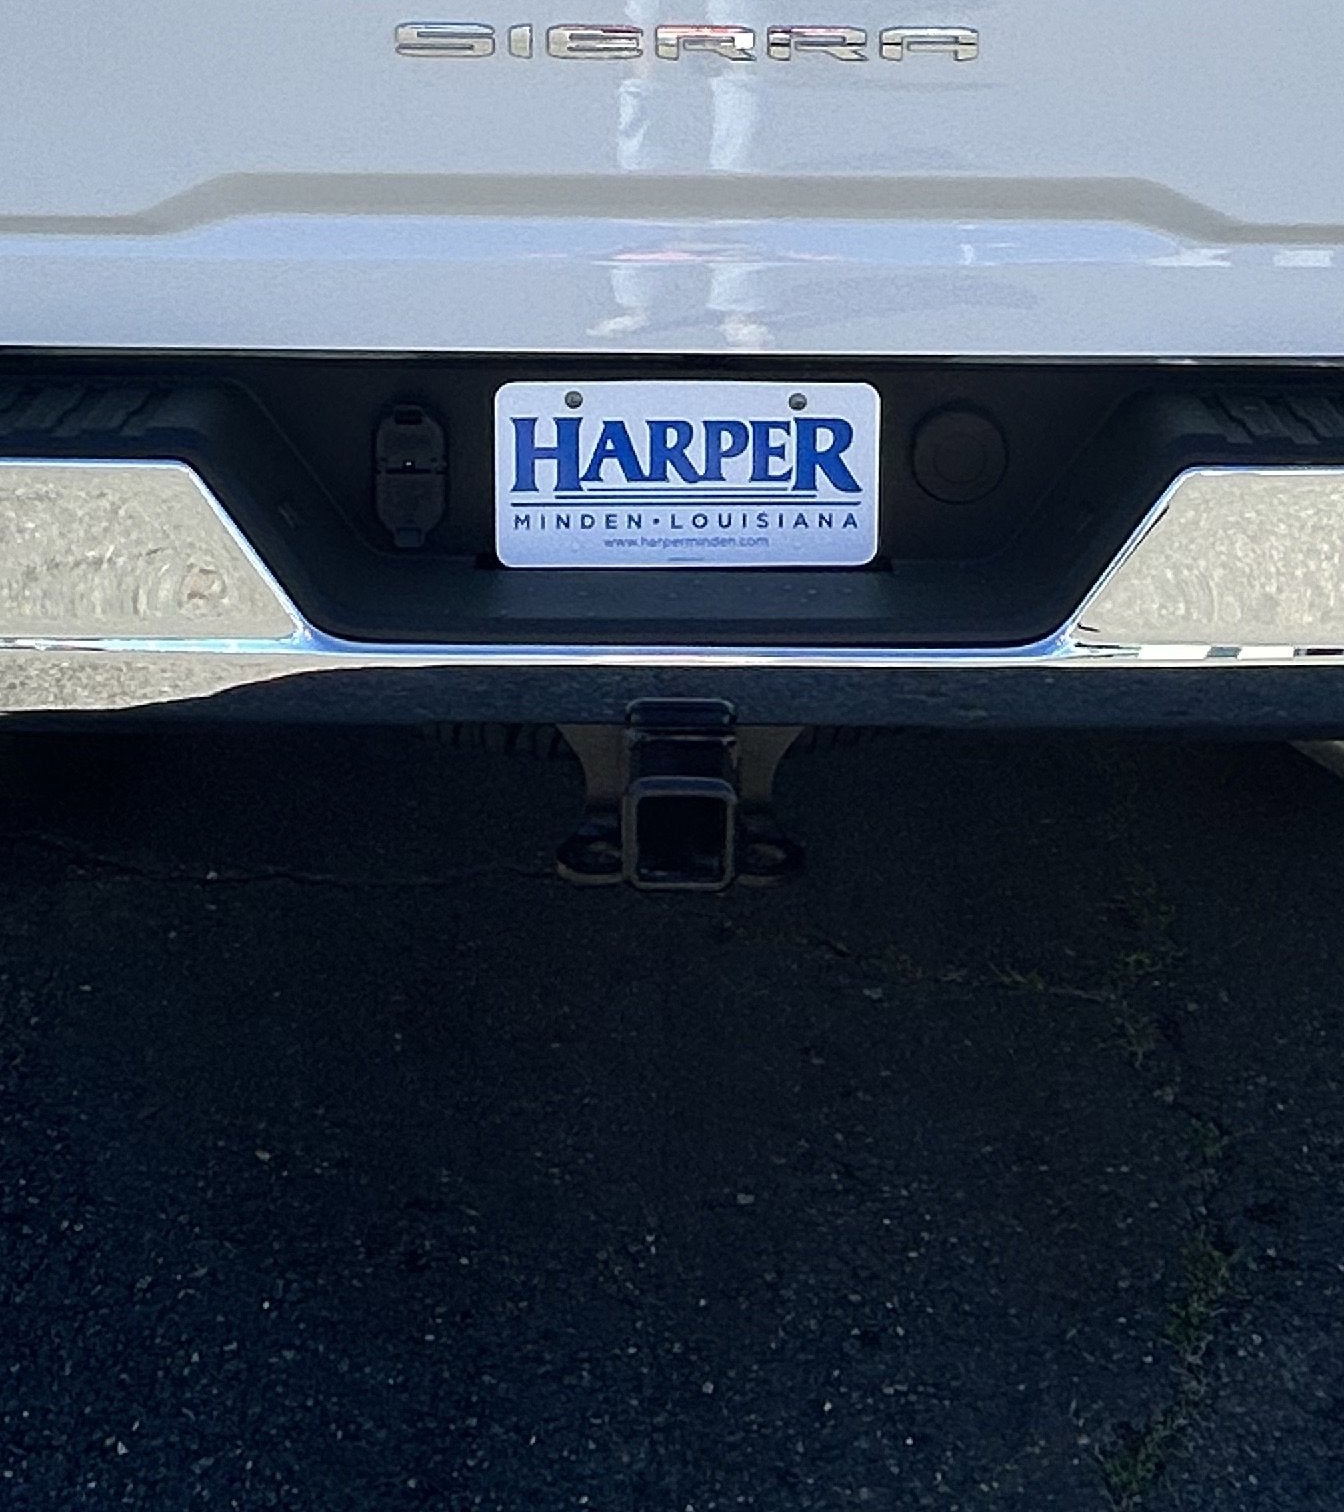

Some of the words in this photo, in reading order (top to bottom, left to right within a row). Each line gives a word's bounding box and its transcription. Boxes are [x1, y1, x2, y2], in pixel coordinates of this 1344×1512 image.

[395, 22, 980, 62] SIERRA
[510, 416, 863, 494] HARPER
[513, 512, 643, 530] MINDEN
[670, 511, 858, 529] LOUISIANA
[604, 535, 770, 550] www.harperminden.com
